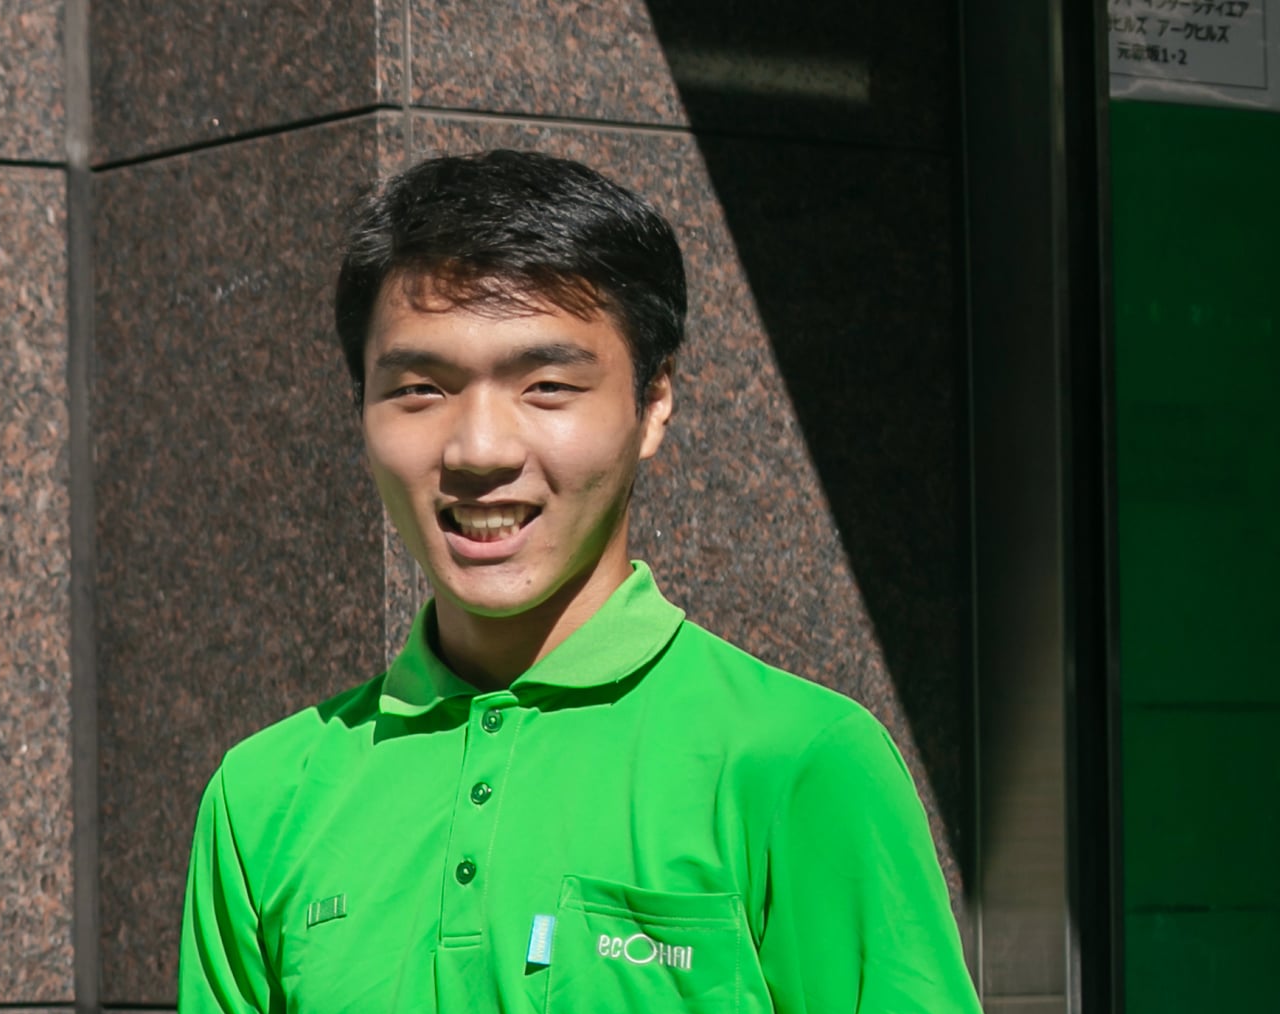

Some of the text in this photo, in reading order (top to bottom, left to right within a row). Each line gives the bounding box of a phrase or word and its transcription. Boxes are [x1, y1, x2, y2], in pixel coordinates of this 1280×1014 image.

[1157, 19, 1231, 43] アークヒルズ
